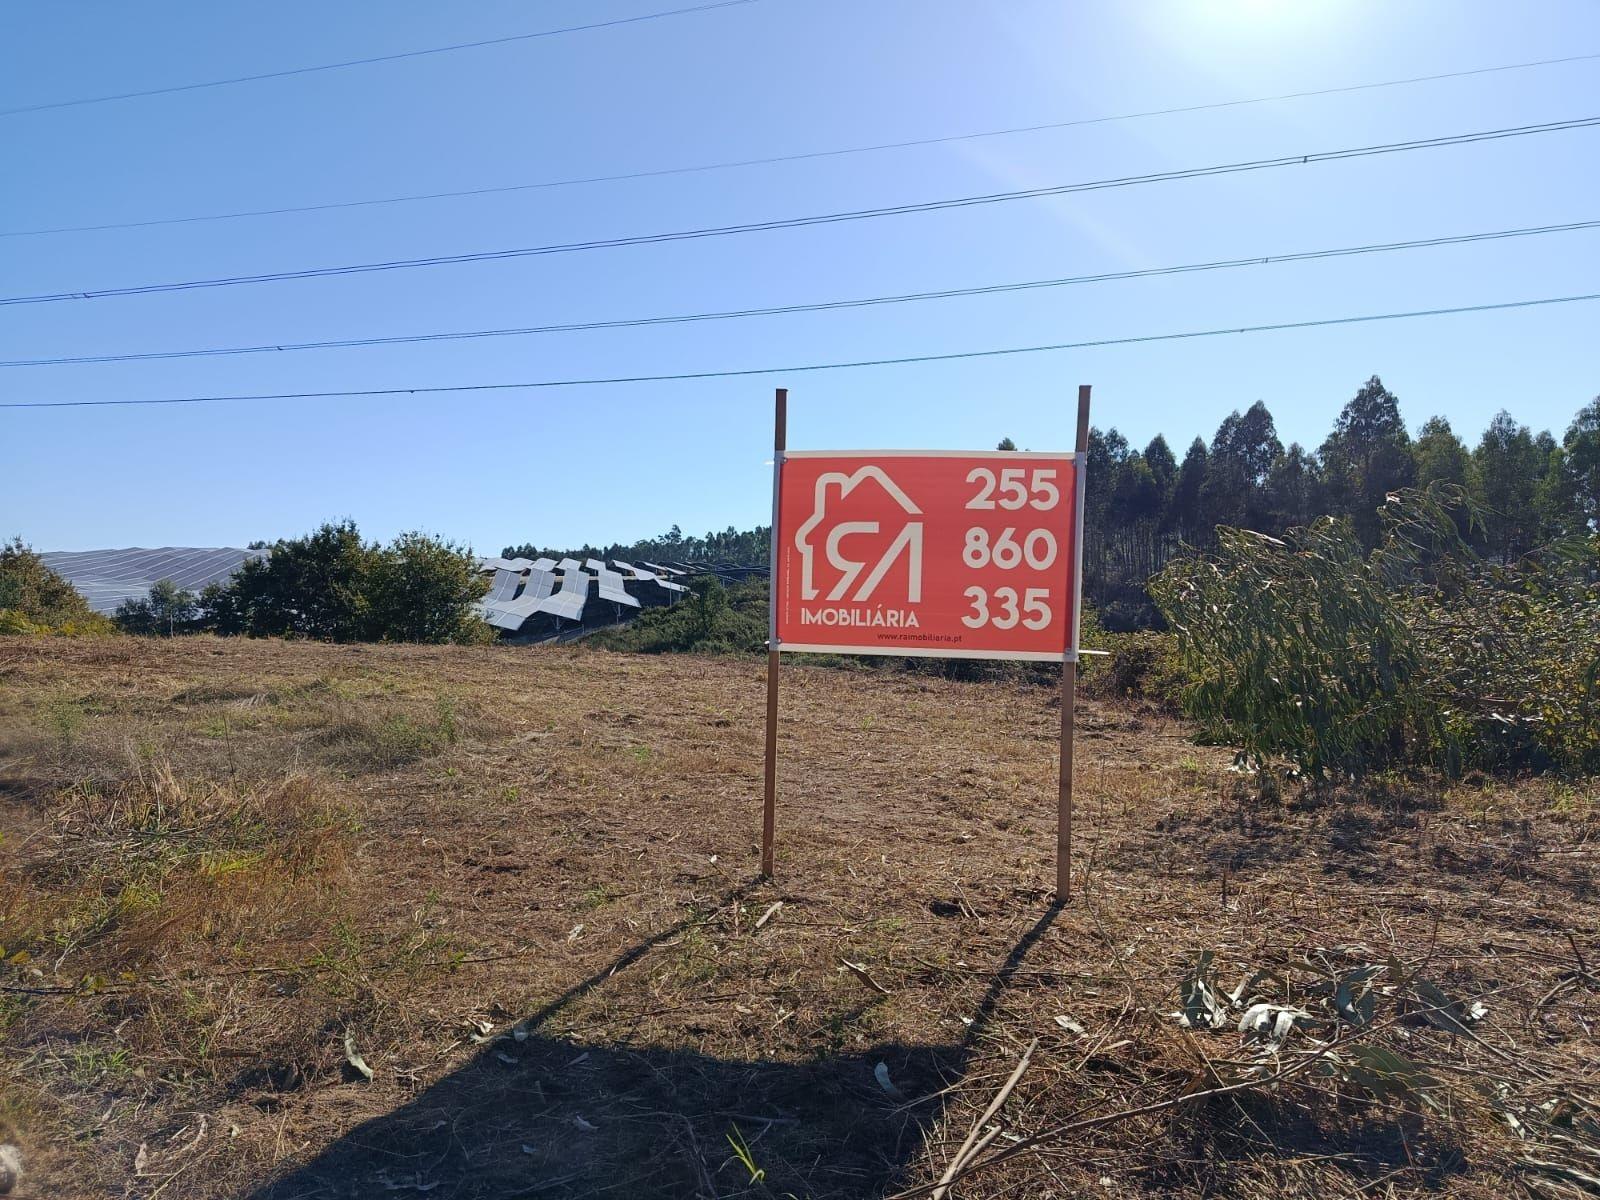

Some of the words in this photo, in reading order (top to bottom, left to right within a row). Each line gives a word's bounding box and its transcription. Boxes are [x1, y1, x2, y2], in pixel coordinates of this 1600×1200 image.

[965, 467, 1059, 511] 255
[963, 526, 1057, 571] 860
[801, 604, 920, 628] IMOBILIÁRIA
[961, 585, 1052, 631] 335
[877, 632, 963, 644] www.raimobiliaria.pt
